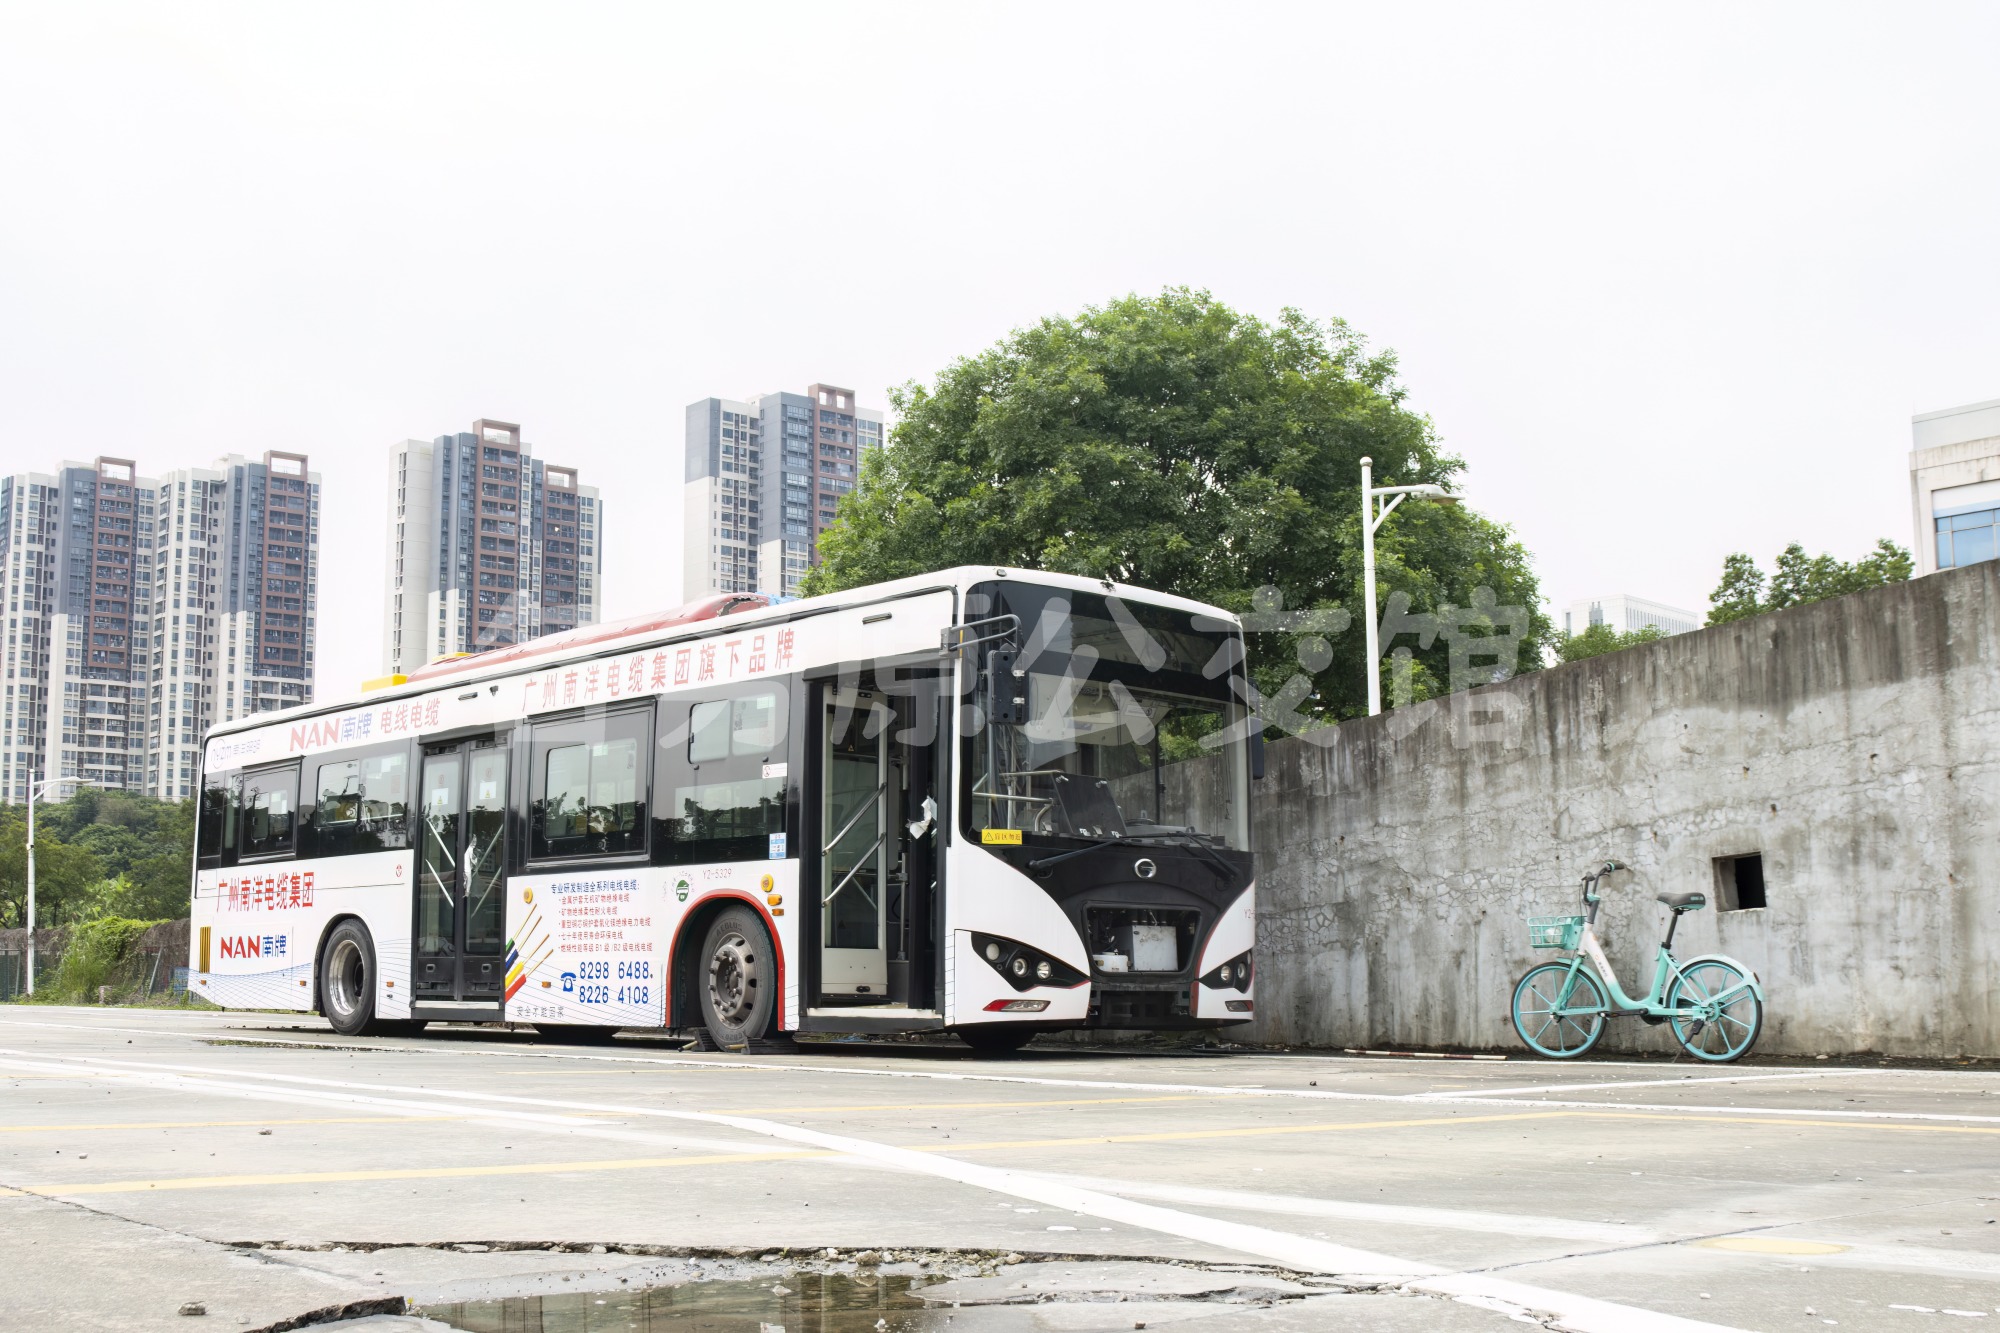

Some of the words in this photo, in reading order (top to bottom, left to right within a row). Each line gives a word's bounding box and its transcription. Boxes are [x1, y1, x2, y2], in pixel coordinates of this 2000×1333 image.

[522, 628, 795, 713] 广州南洋电缆集团旗下品牌
[380, 697, 441, 735] 电线电缆
[289, 717, 341, 752] NAN
[216, 871, 315, 913] 广州南洋电缆集团
[220, 935, 261, 959] NAN
[262, 934, 287, 958] 南牌
[579, 961, 610, 980] 8298
[618, 961, 649, 980] 6488
[579, 985, 609, 1004] 8226
[617, 985, 649, 1004] 4108
